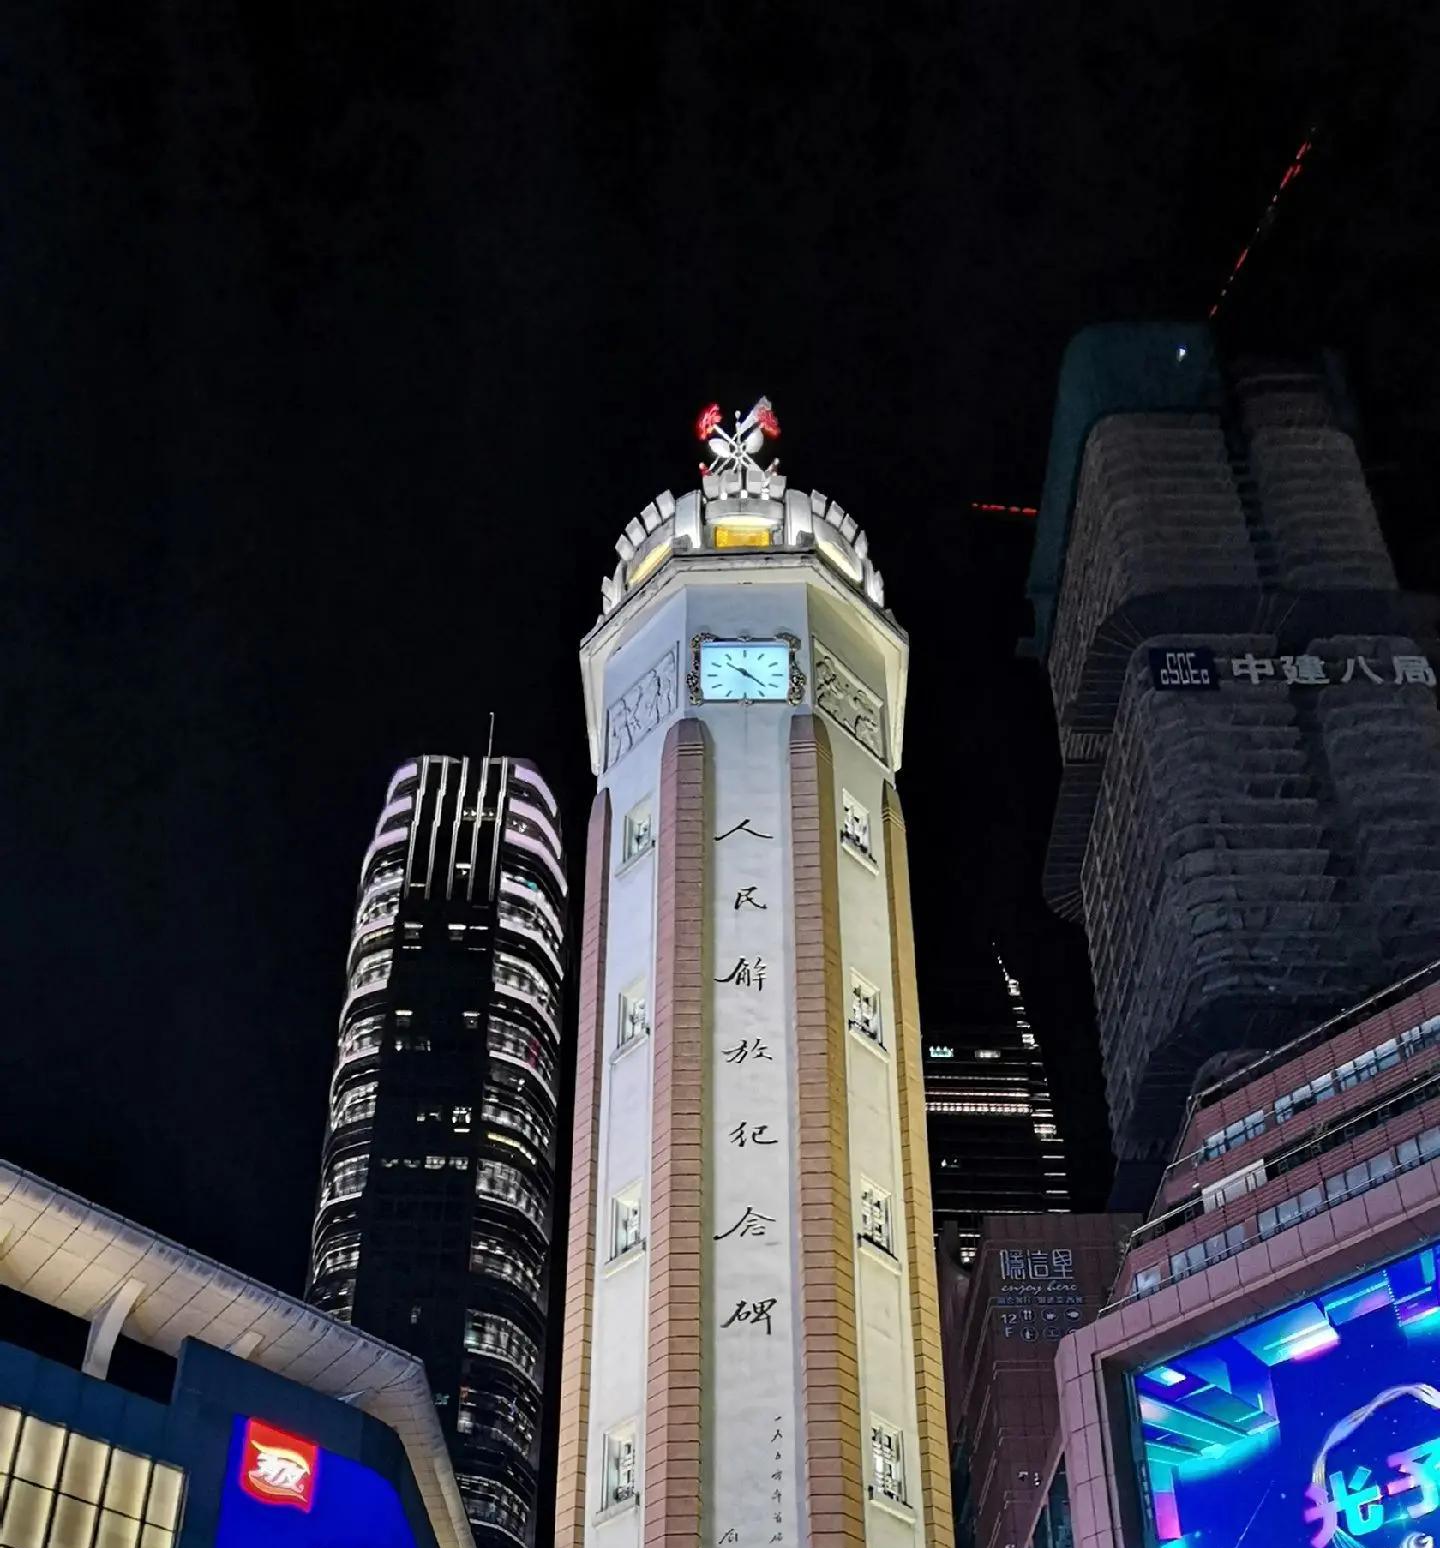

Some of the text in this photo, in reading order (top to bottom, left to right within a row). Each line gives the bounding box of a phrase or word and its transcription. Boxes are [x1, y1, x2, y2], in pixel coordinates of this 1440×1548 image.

[1231, 653, 1438, 687] 中建八局
[1001, 1314, 1017, 1324] 12
